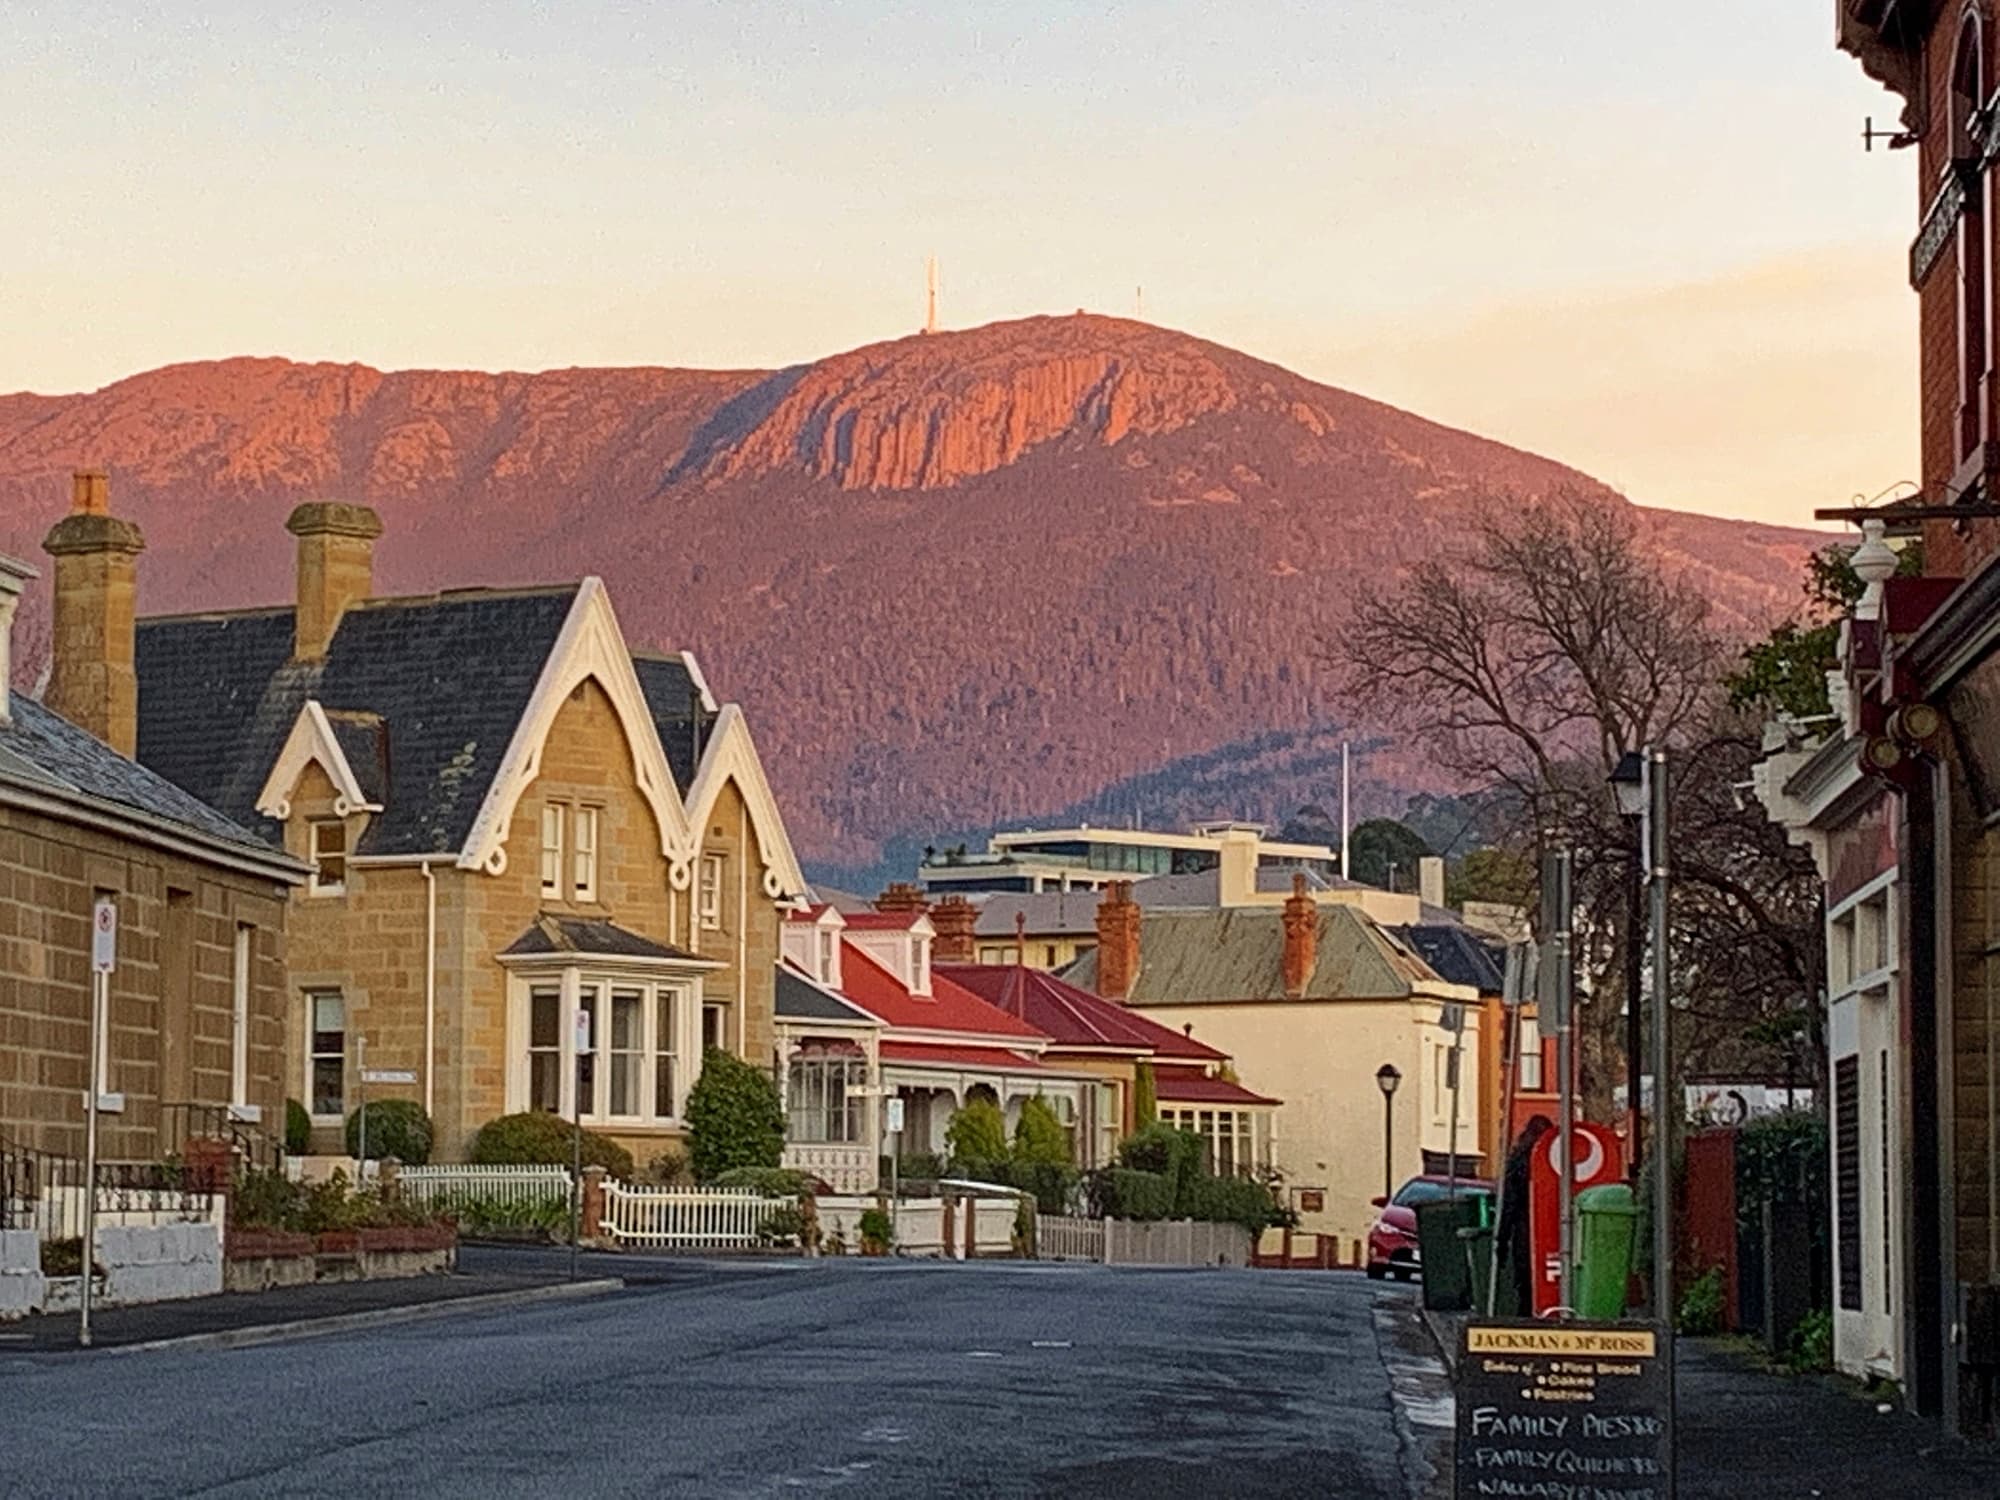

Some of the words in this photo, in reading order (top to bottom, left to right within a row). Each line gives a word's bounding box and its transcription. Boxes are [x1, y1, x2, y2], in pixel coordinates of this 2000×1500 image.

[1474, 1333, 1560, 1349] JACKMAN
[1548, 1375, 1595, 1388] Cakes
[1533, 1388, 1595, 1401] Pastries
[1473, 1406, 1568, 1438] FAMILY
[1476, 1447, 1555, 1469] FAMILY
